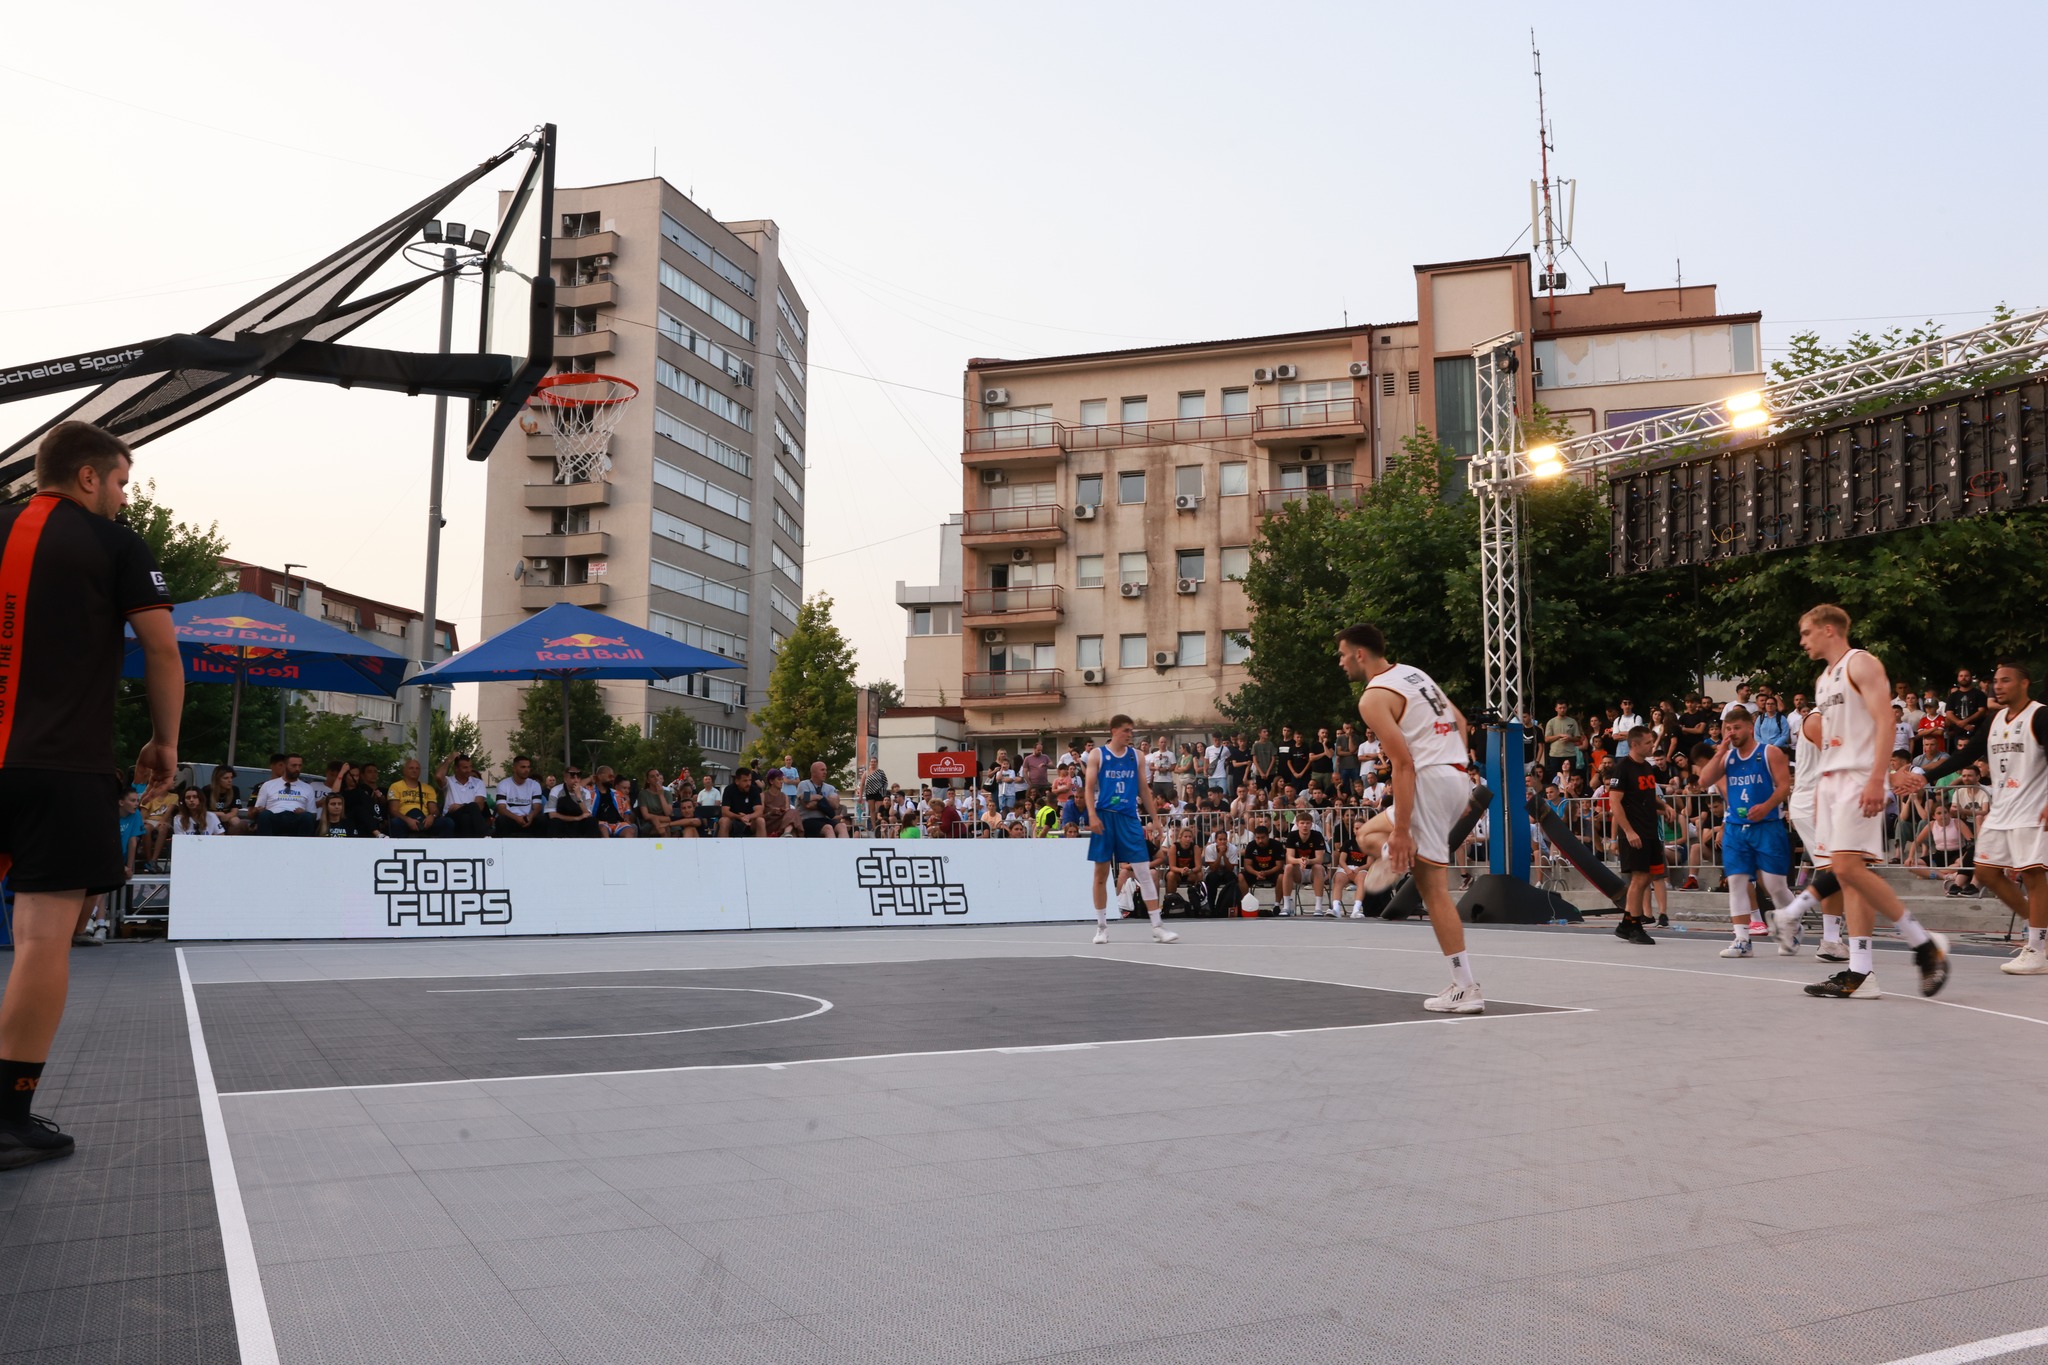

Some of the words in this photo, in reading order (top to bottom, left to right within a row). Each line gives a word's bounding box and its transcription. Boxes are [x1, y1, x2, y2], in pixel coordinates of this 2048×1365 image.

[0, 363, 76, 385] Schelde
[79, 349, 144, 370] Sports
[2, 592, 17, 639] COURT
[174, 625, 234, 638] Red
[238, 629, 295, 644] Bull
[535, 648, 590, 661] Red
[593, 648, 644, 660] Bull
[933, 765, 963, 773] vitaminka
[1105, 769, 1135, 779] KOSOVA
[1740, 788, 1749, 803] 4
[388, 889, 512, 926] FLIPS
[869, 884, 968, 916] FLIPS
